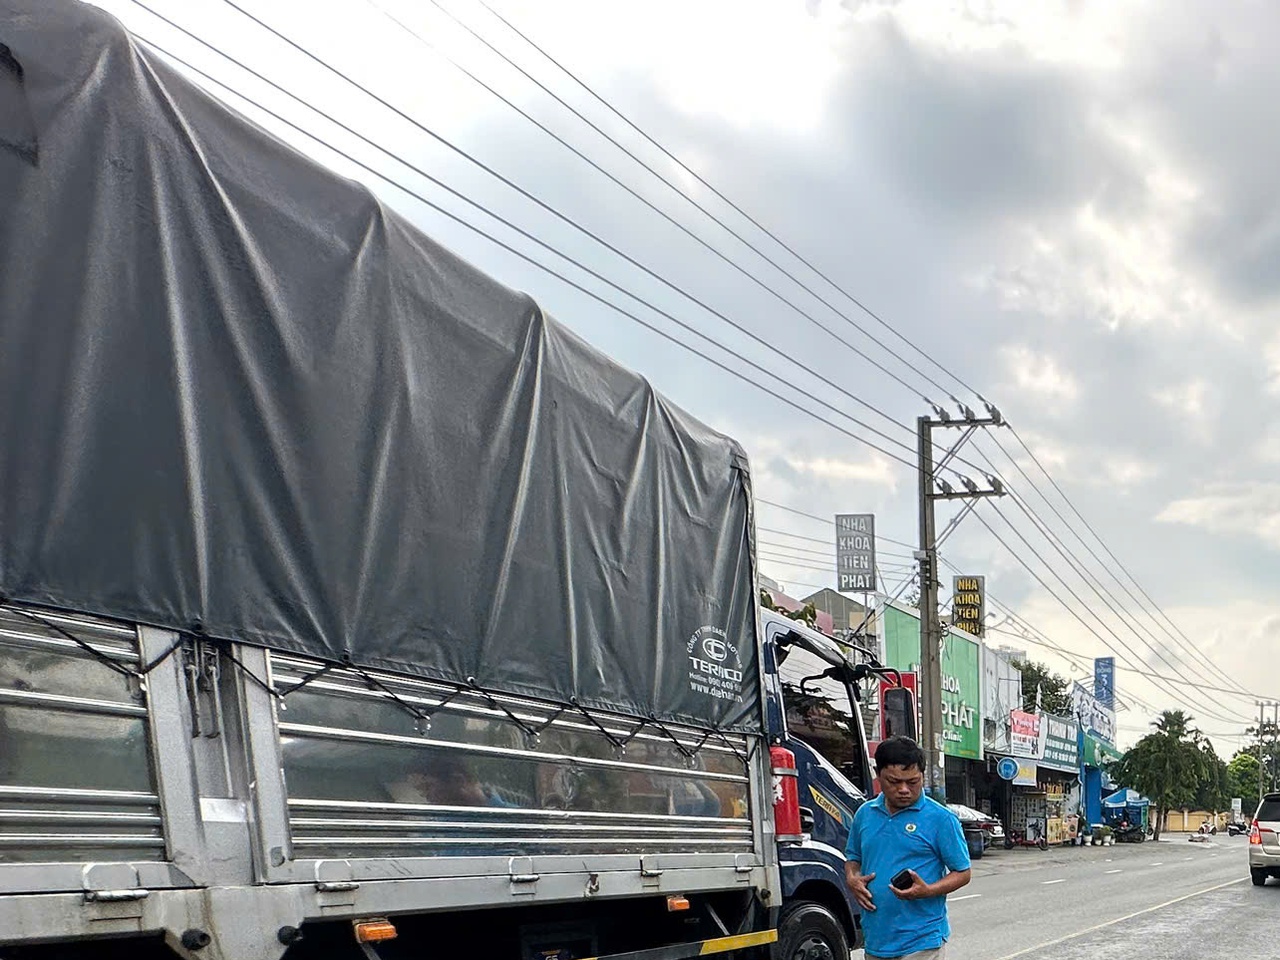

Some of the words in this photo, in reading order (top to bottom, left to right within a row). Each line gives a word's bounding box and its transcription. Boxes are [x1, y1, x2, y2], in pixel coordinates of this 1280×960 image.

[842, 518, 866, 531] NHA
[839, 536, 870, 550] KHOA
[957, 579, 978, 591] NHA
[955, 593, 981, 605] KHOA
[942, 672, 961, 695] HOA
[943, 729, 963, 743] Clinic
